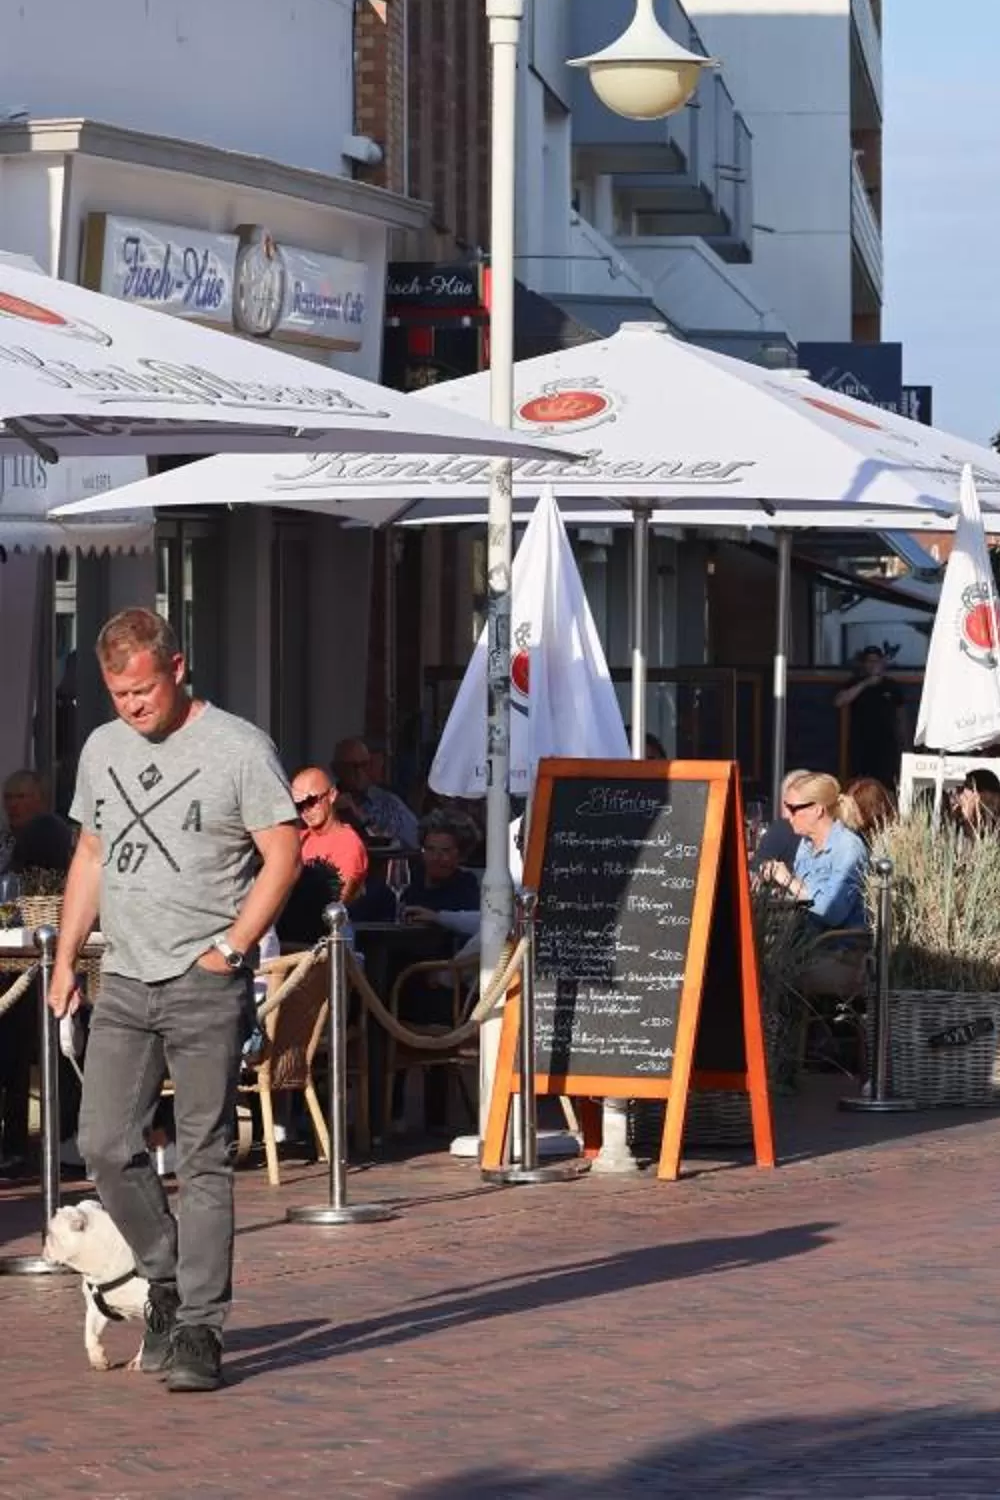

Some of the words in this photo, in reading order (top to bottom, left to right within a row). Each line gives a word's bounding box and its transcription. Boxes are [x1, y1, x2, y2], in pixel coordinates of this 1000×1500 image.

[123, 236, 226, 311] Fisch-Hüs
[181, 799, 202, 833] A
[117, 841, 149, 874] 87
